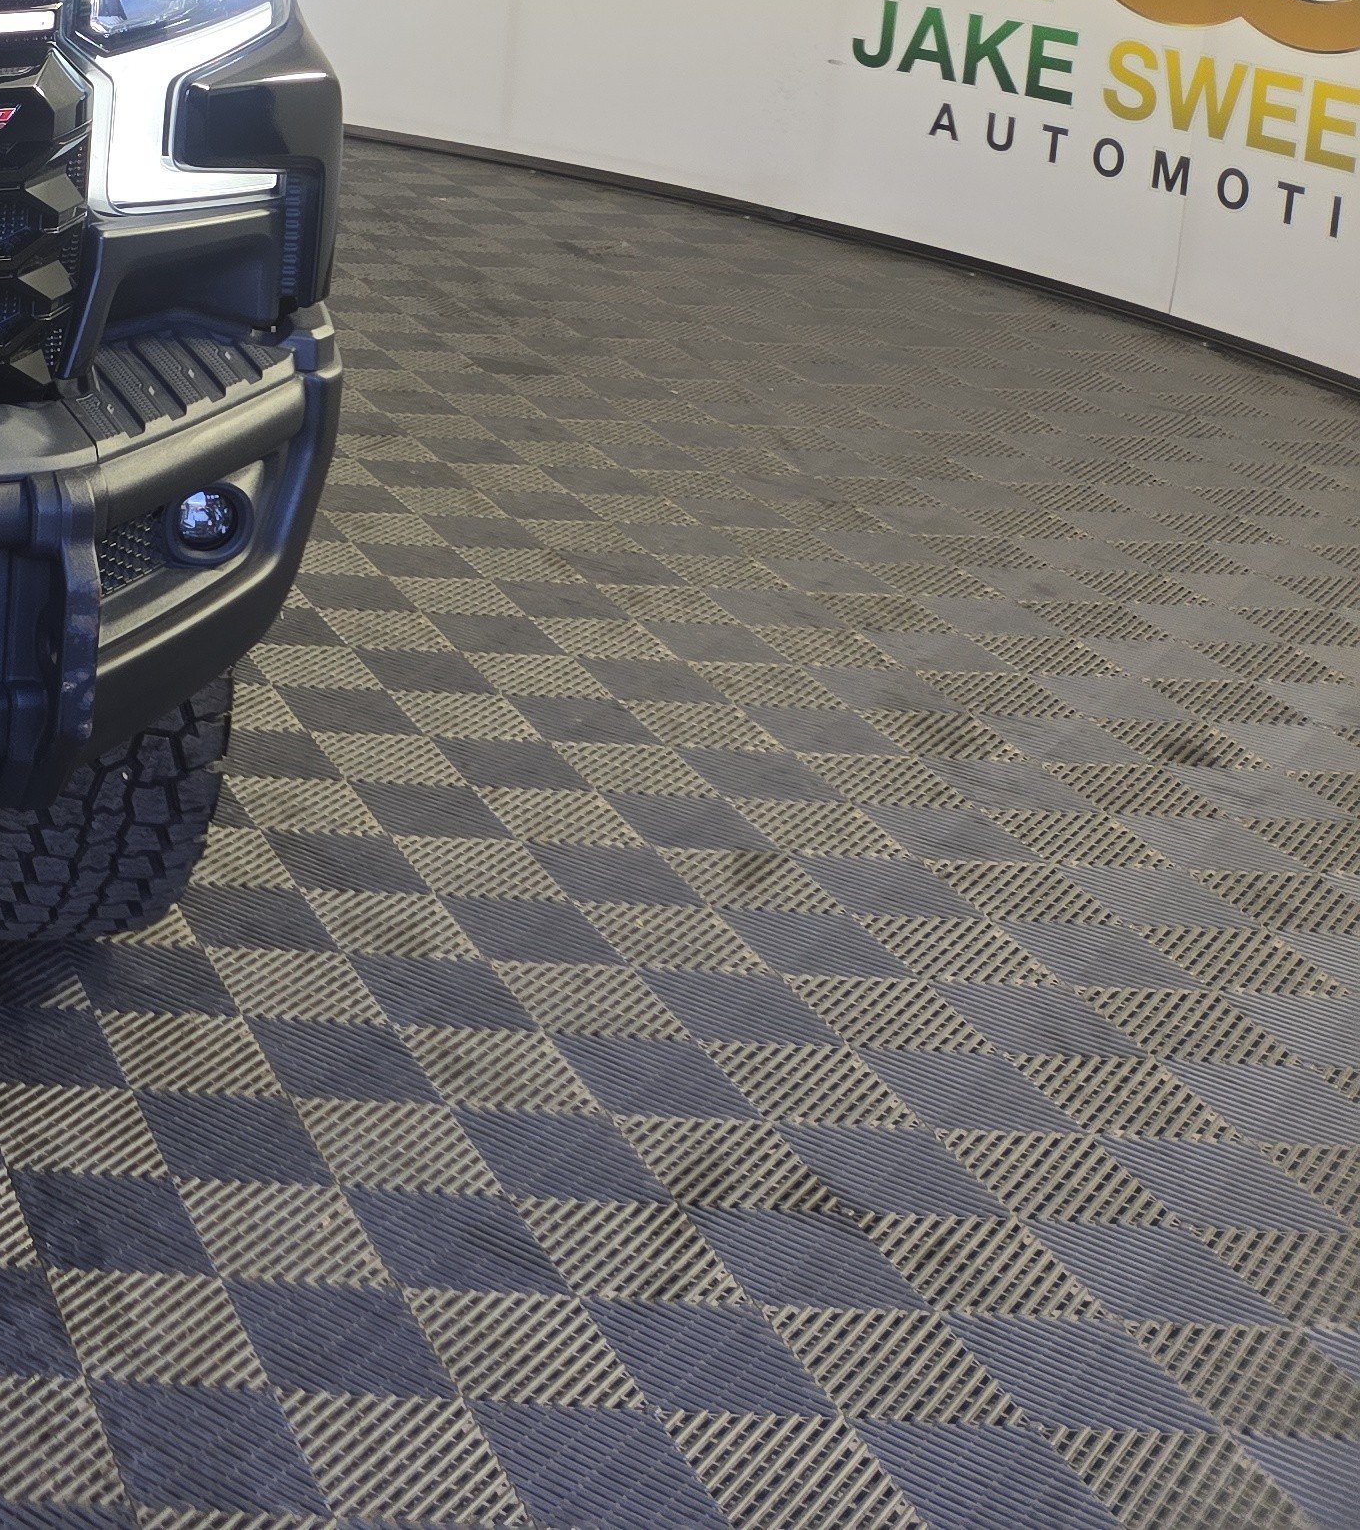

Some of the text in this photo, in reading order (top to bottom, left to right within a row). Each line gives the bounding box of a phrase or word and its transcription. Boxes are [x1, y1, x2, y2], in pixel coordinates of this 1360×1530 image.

[852, 0, 1360, 174] JAKE SWEE
[928, 102, 1343, 238] AUTOMOTI
